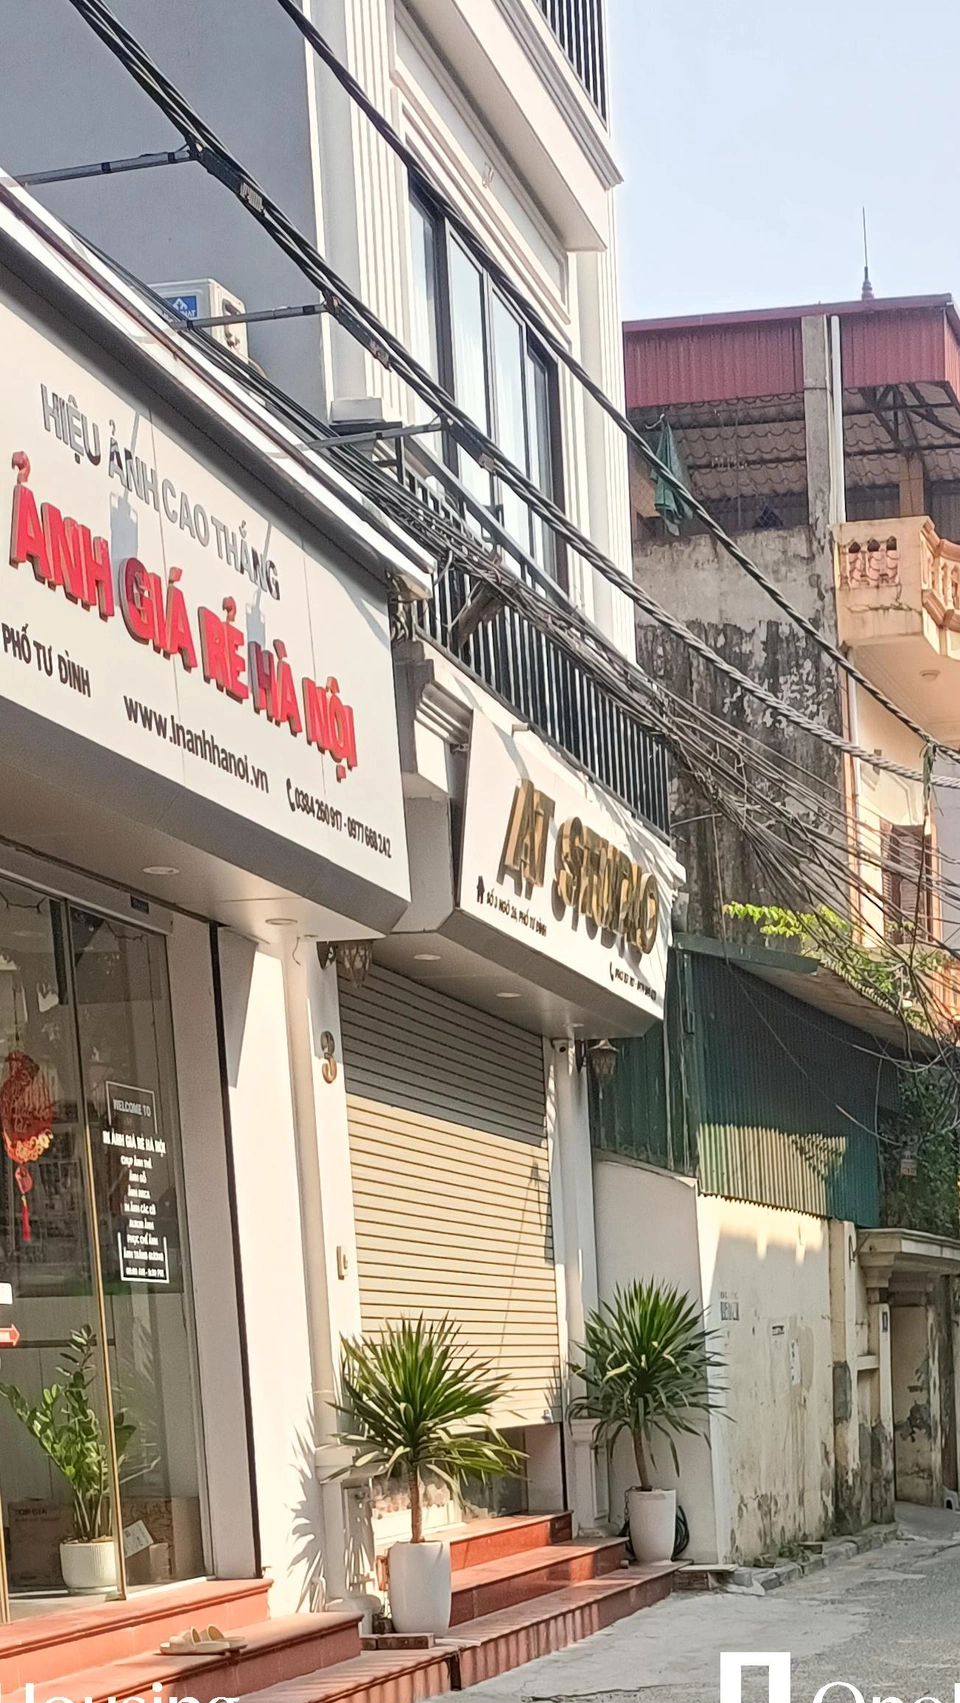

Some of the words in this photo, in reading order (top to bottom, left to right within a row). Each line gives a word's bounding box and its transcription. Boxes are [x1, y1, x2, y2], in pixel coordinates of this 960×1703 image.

[41, 383, 101, 466] HIỆU
[109, 419, 160, 512] ẢNH
[162, 478, 210, 547] CAO
[211, 515, 280, 600] THẮNG
[1, 623, 32, 664] PHỐ
[58, 650, 92, 697] ĐÌNH
[10, 451, 115, 622] ẢNH
[119, 557, 198, 673] GIÁ
[198, 596, 249, 704] RẺ
[248, 638, 303, 737] HÀ
[302, 676, 357, 783] NỘI
[112, 1098, 143, 1116] WELCOME
[143, 1105, 152, 1118] TO
